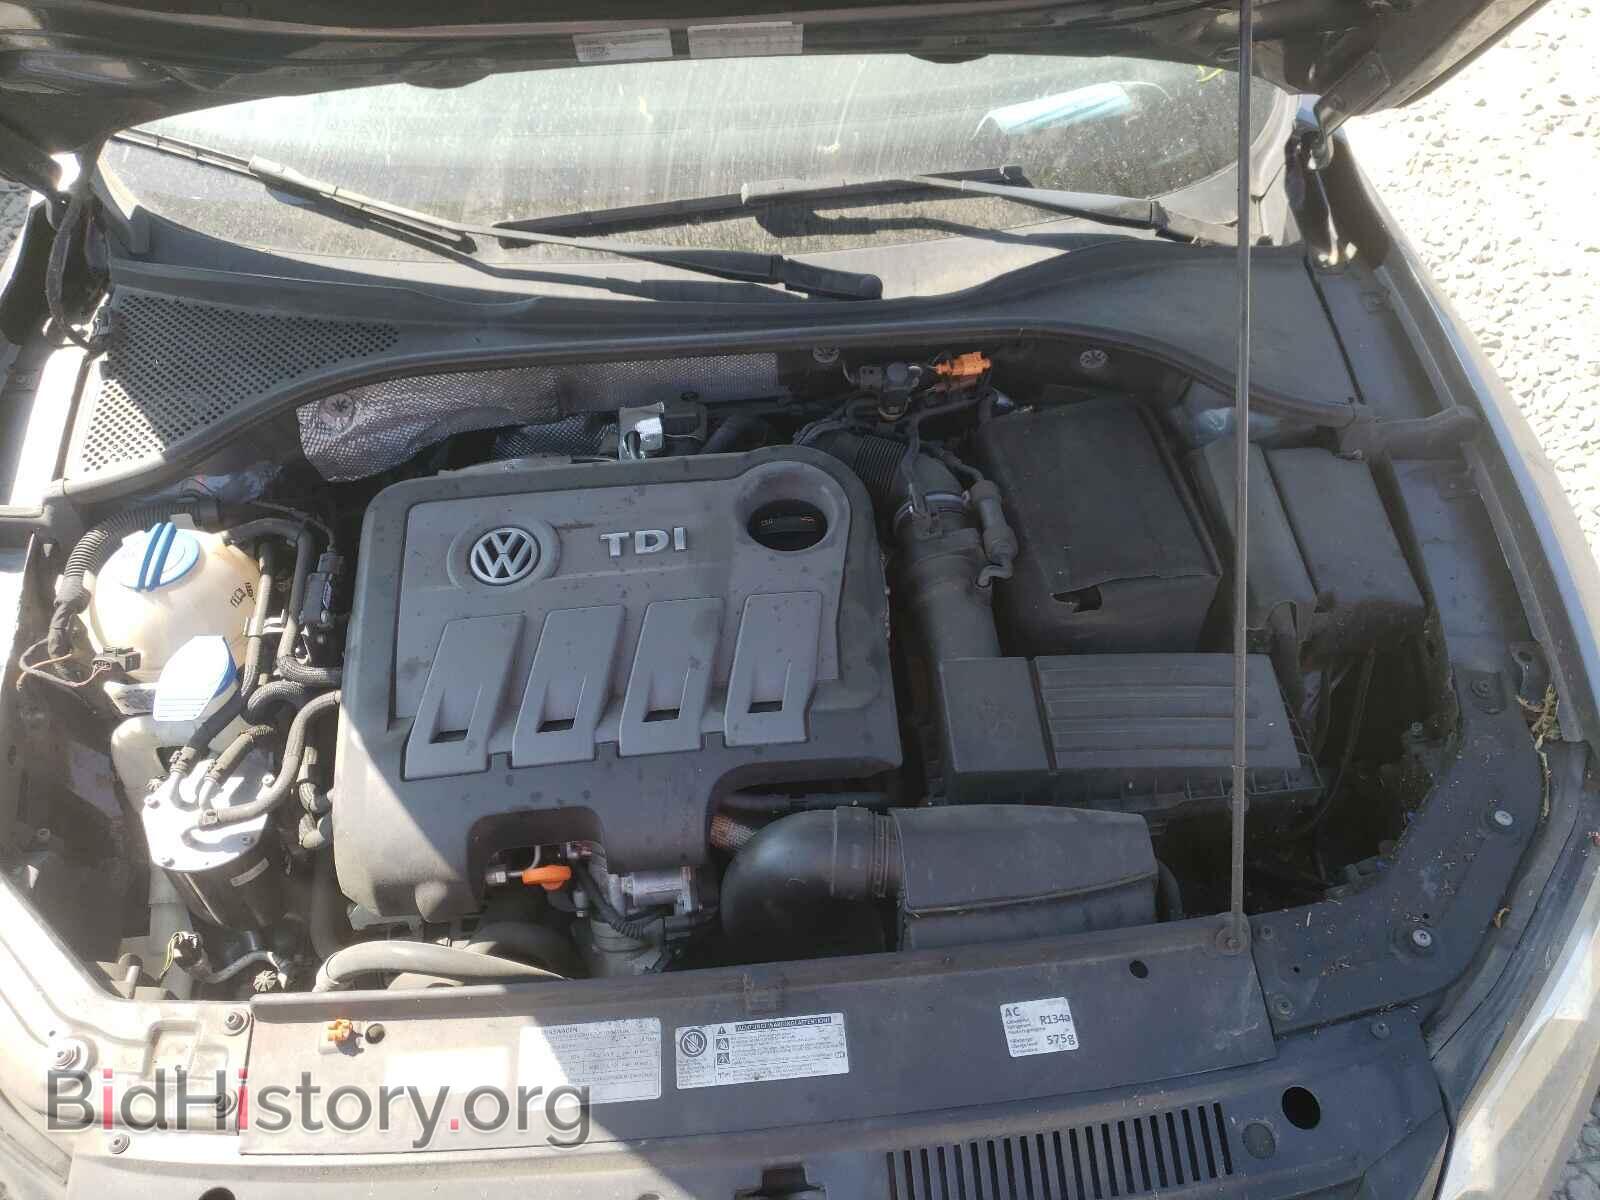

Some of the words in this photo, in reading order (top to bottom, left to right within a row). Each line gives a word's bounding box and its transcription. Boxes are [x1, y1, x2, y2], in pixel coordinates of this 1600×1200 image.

[600, 526, 689, 557] TDI
[1005, 1006, 1021, 1018] AC
[1039, 1013, 1071, 1026] R134a
[1046, 1033, 1076, 1046] 575g
